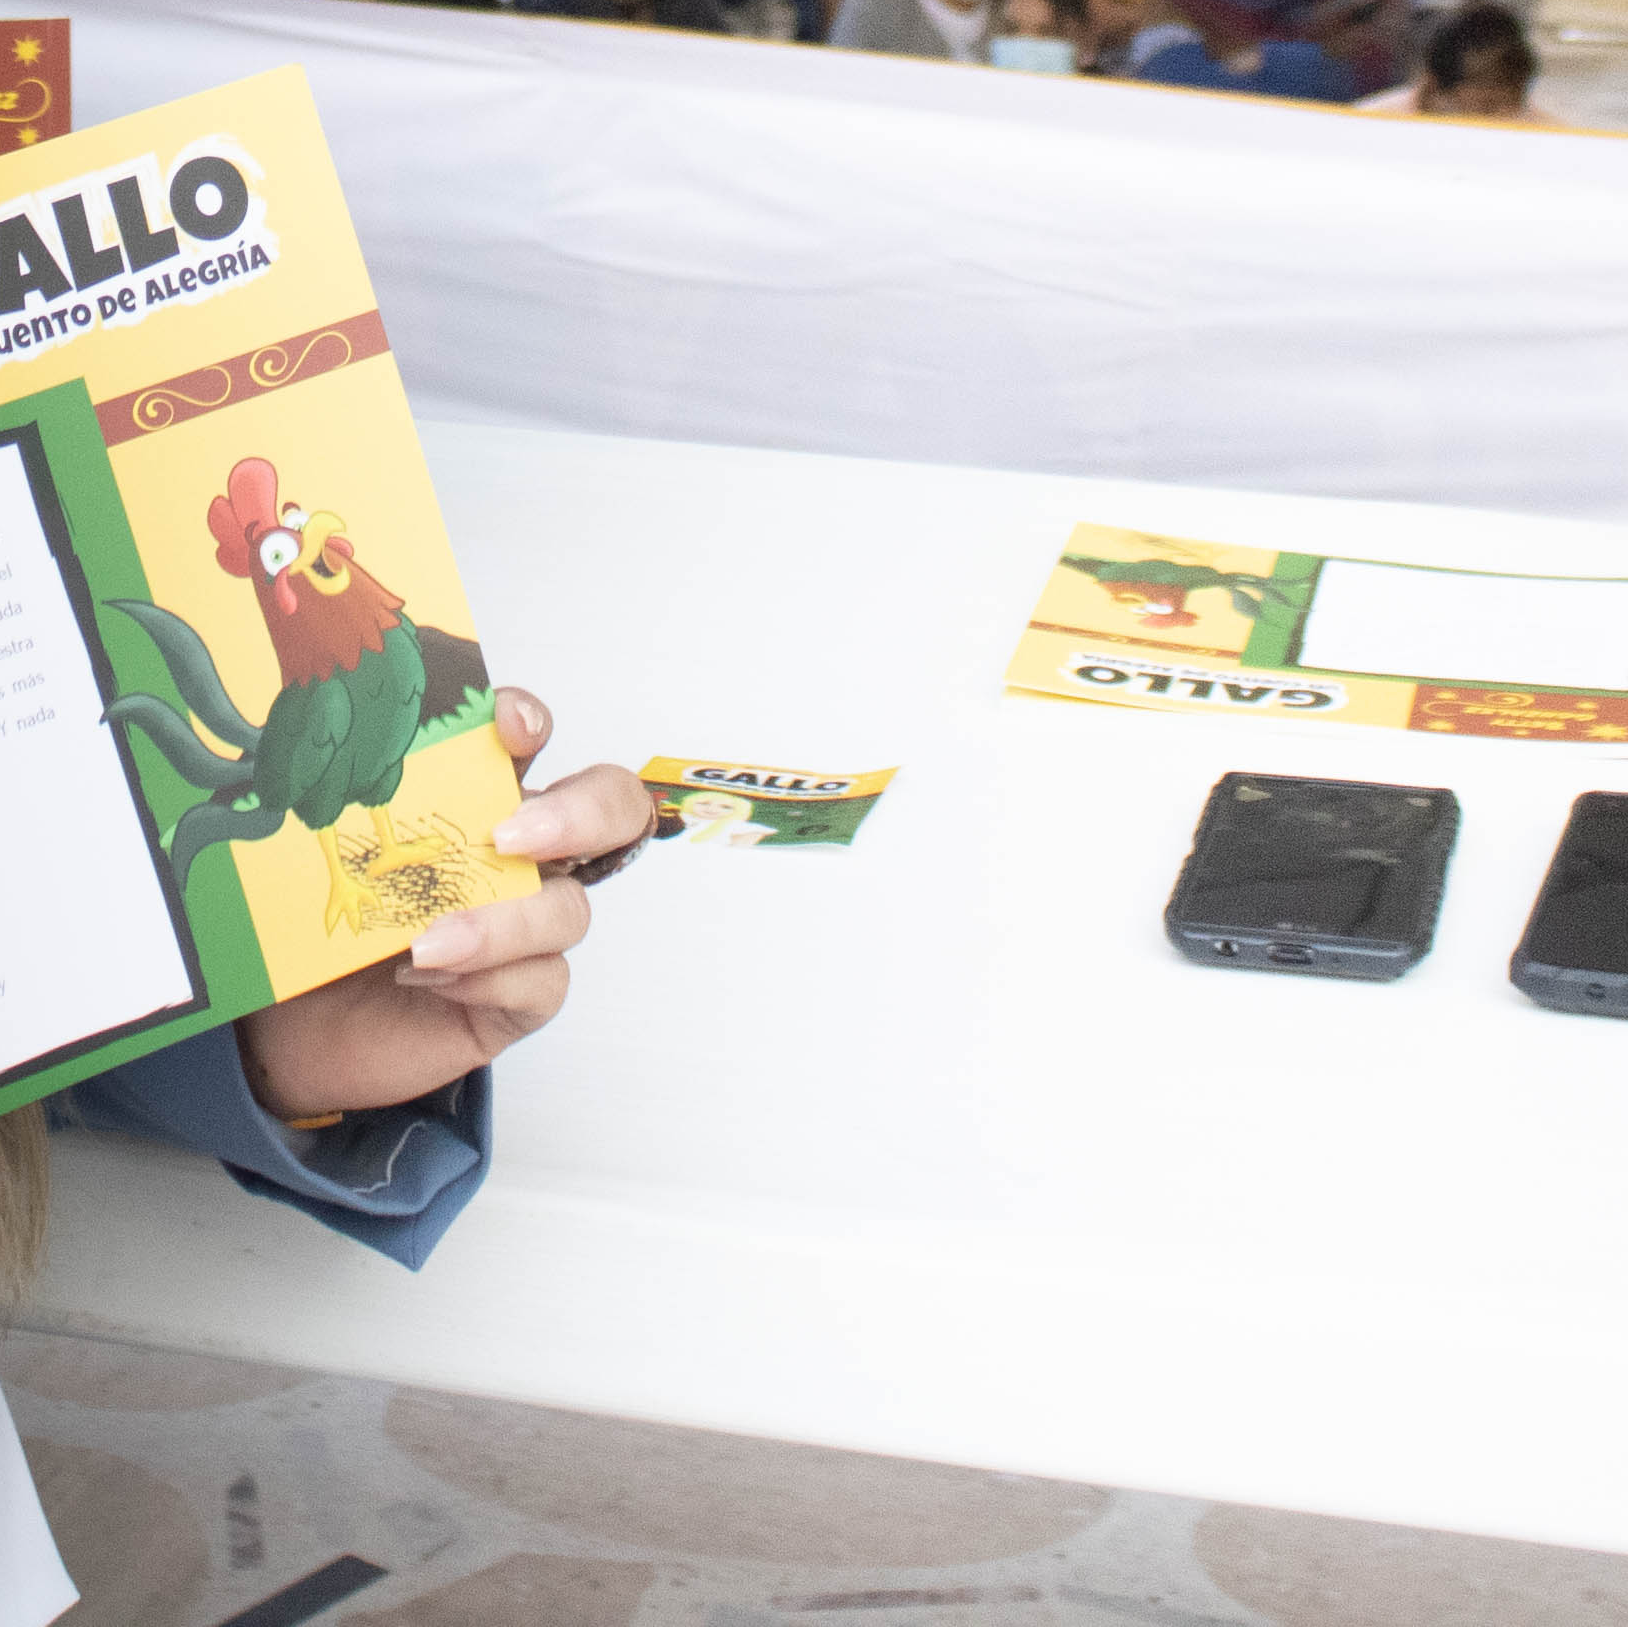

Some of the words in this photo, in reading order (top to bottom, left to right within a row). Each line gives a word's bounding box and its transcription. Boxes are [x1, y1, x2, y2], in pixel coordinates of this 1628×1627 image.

[12, 673, 45, 693] más
[1074, 665, 1333, 709] GALLO
[16, 706, 56, 731] nada
[691, 768, 850, 791] GALLO
